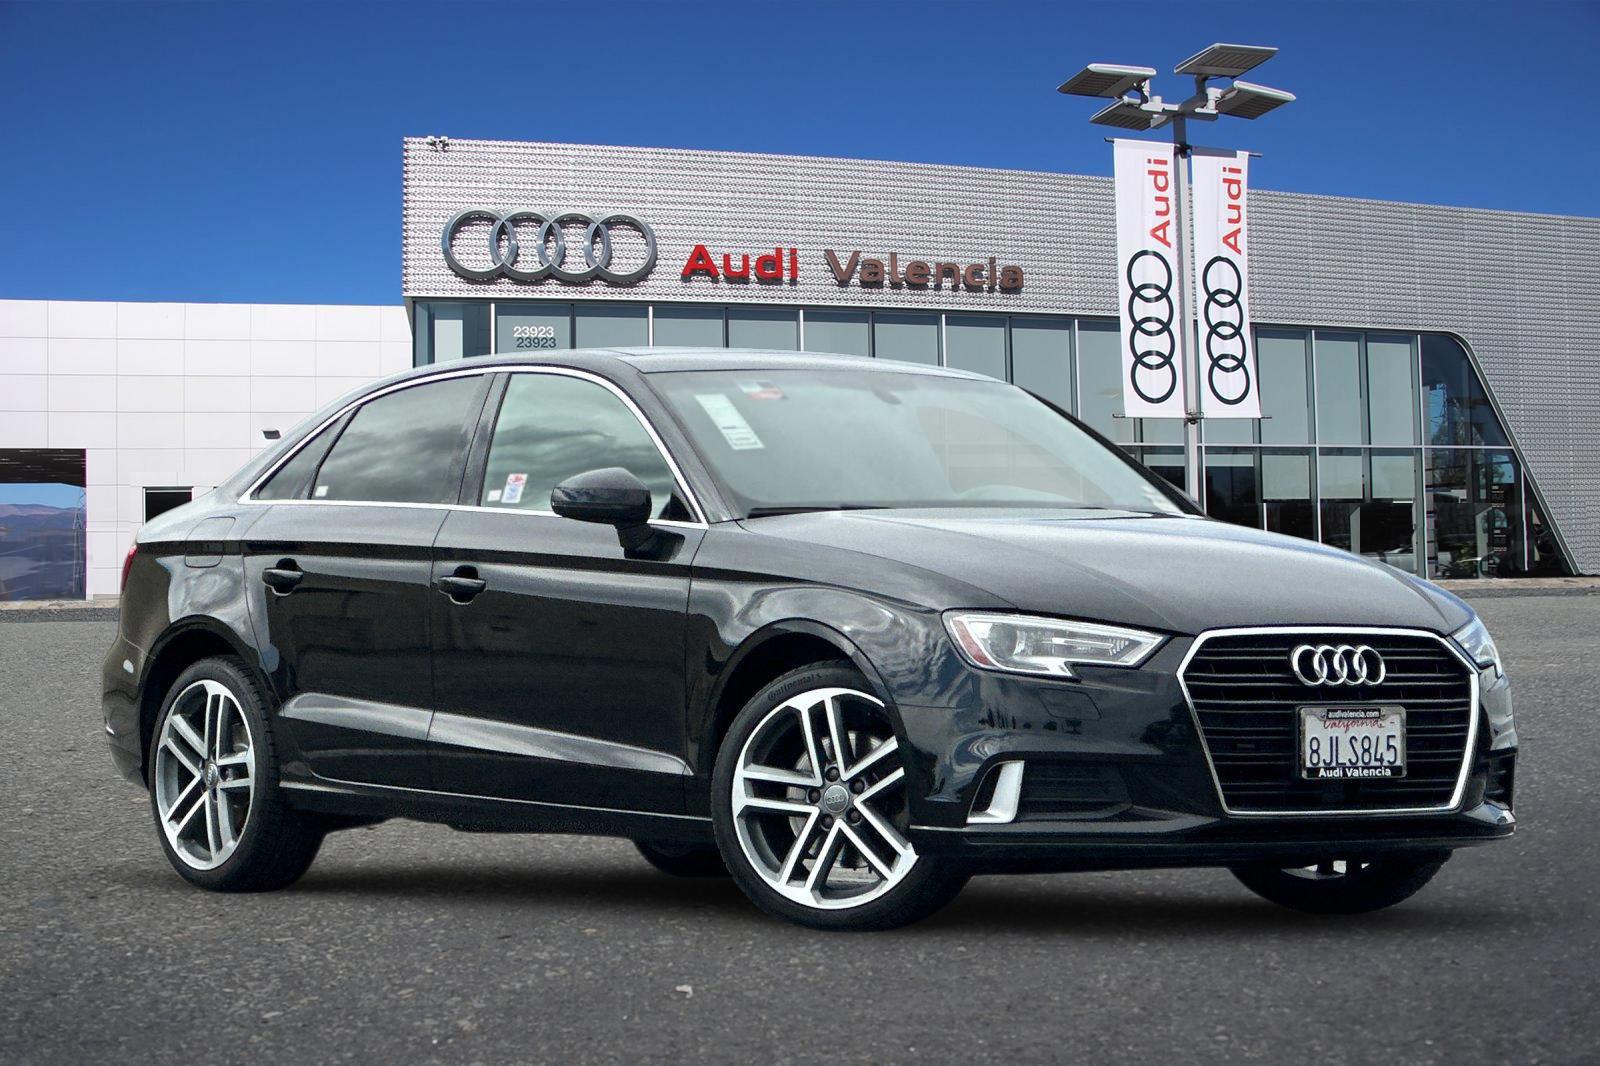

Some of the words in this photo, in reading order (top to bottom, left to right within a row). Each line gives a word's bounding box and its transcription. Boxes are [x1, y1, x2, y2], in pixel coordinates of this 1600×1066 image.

[1147, 158, 1172, 249] Audi
[1222, 166, 1242, 256] Audi
[681, 244, 799, 283] Audi
[824, 249, 1024, 291] Valencia
[513, 326, 554, 337] 23923
[516, 337, 557, 348] 23923
[1328, 709, 1380, 719] audivalencia.com
[1309, 734, 1397, 767] 8JLS845
[1318, 767, 1343, 777] Audi
[1346, 767, 1391, 777] Valencia
